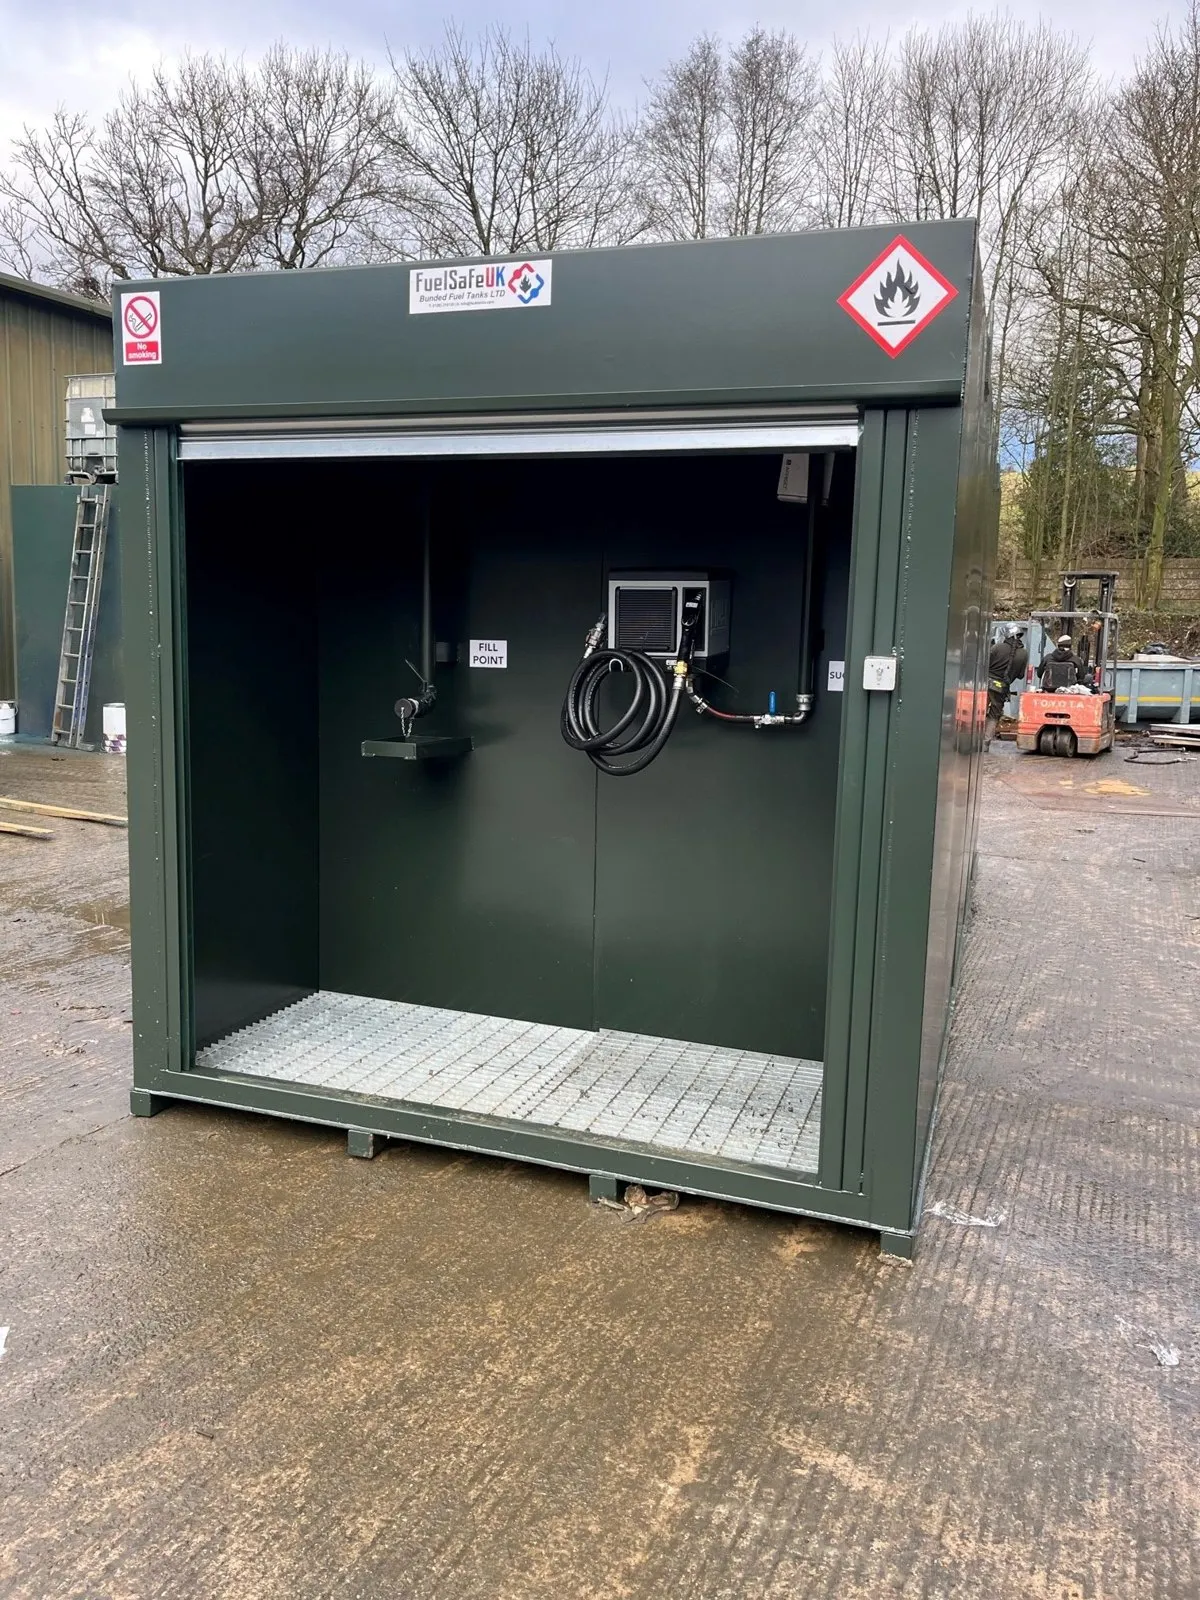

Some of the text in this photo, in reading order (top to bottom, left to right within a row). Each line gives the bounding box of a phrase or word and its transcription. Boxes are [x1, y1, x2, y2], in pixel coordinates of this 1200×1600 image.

[419, 289, 506, 303] Bunded Fuel Tanks LTD
[137, 342, 148, 350] No
[128, 351, 157, 359] smoking
[479, 643, 498, 651] FILL
[473, 656, 504, 664] POINT
[1033, 699, 1084, 709] TOYOTA
